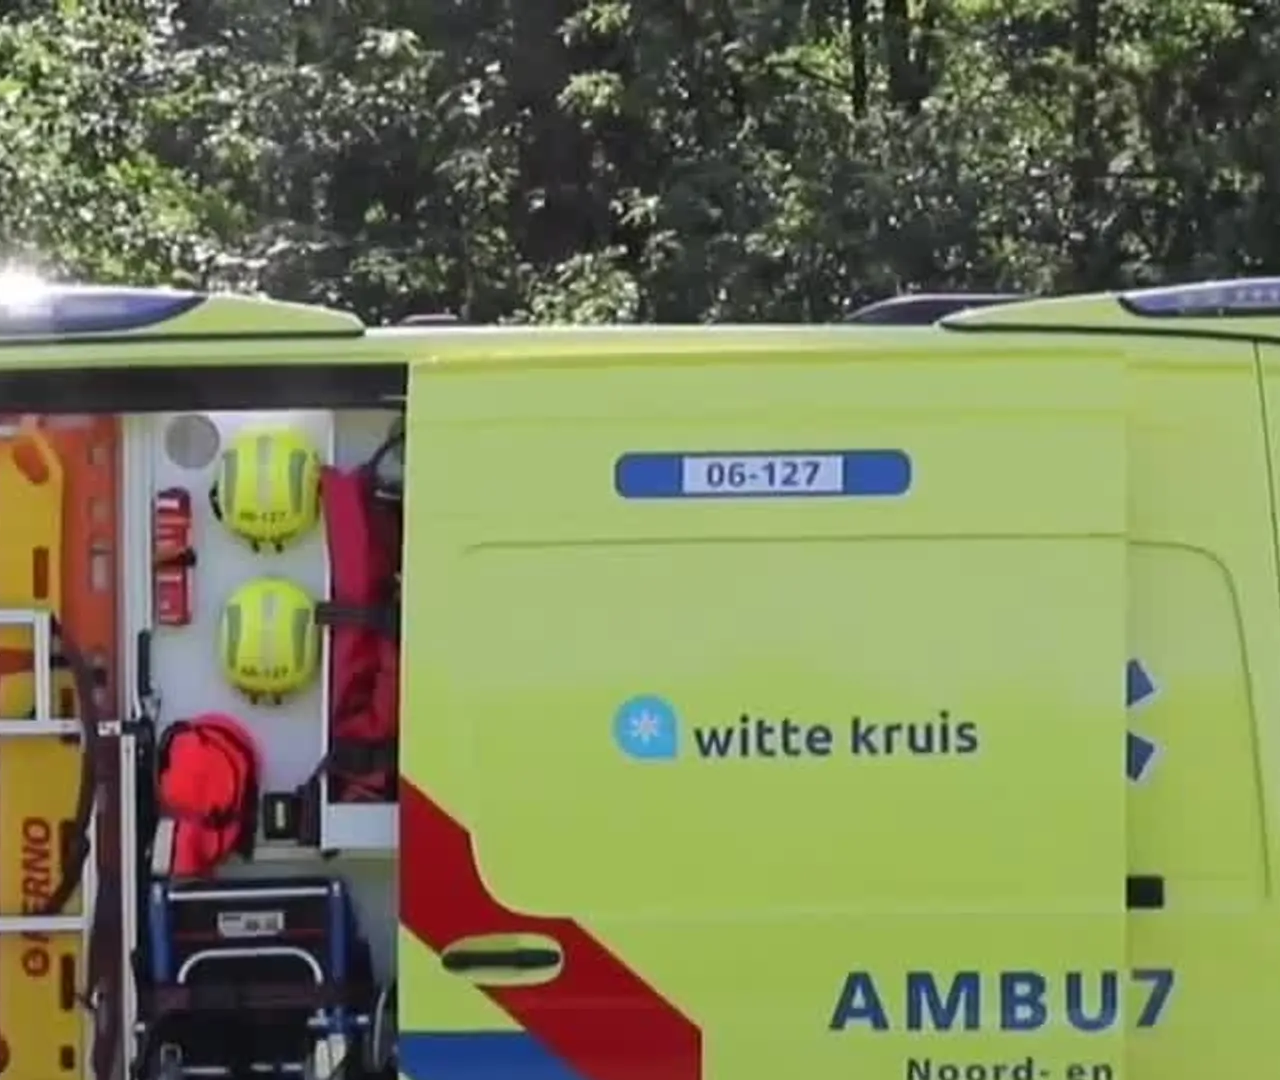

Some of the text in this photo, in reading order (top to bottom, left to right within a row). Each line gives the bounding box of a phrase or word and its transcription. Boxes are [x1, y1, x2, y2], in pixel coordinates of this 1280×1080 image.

[705, 460, 821, 488] 06-127
[694, 711, 979, 759] witte kruis
